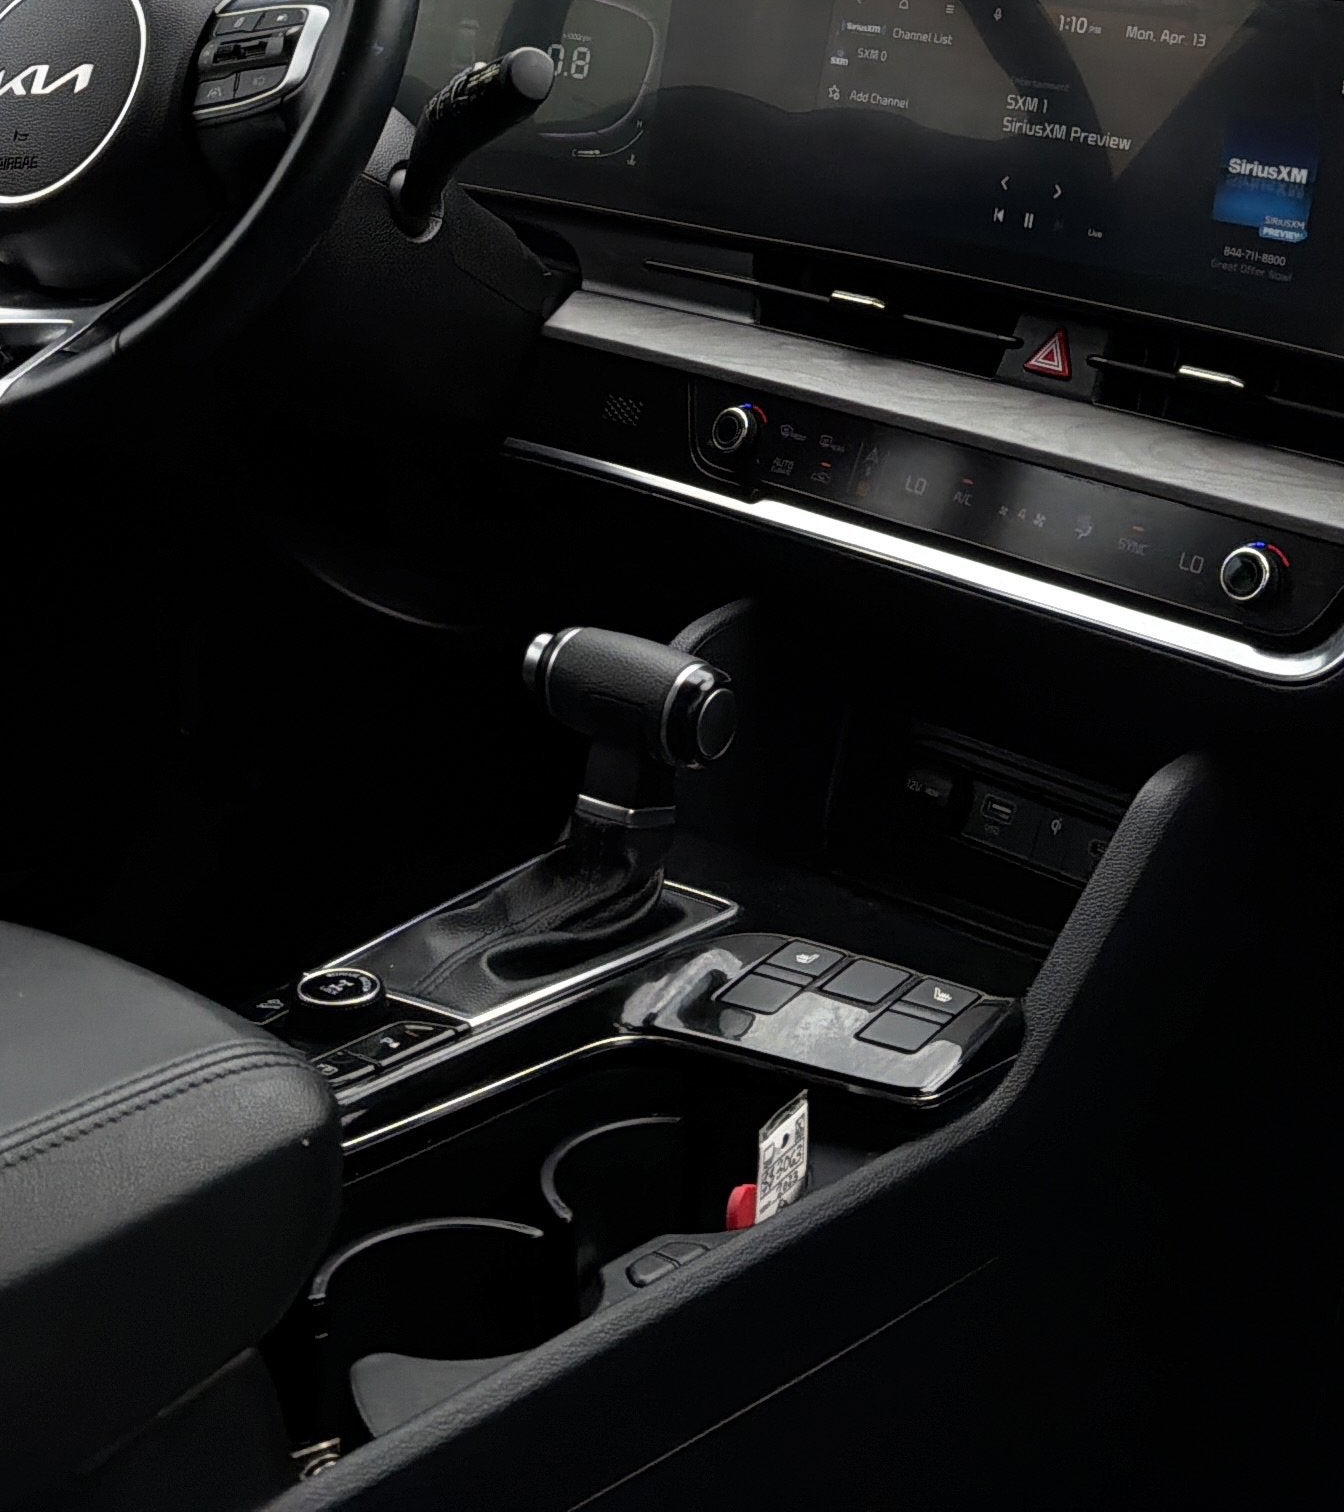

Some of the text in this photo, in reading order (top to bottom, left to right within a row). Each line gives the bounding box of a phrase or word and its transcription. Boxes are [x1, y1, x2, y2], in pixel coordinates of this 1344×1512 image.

[1058, 14, 1088, 34] 1:10
[892, 27, 953, 46] Channel List
[1192, 33, 1207, 47] 13
[548, 43, 592, 80] 0.8
[857, 47, 879, 61] SXM
[849, 90, 909, 109] Add Channel
[1006, 94, 1048, 114] SXM 1
[1002, 116, 1132, 151] SiriusXM Preview
[1227, 157, 1309, 185] SiriusXM
[1264, 215, 1306, 230] SIRIUSXM
[905, 474, 928, 496] LO
[953, 491, 974, 507] A/C
[1117, 538, 1150, 557] SYNC
[1178, 551, 1205, 575] LO
